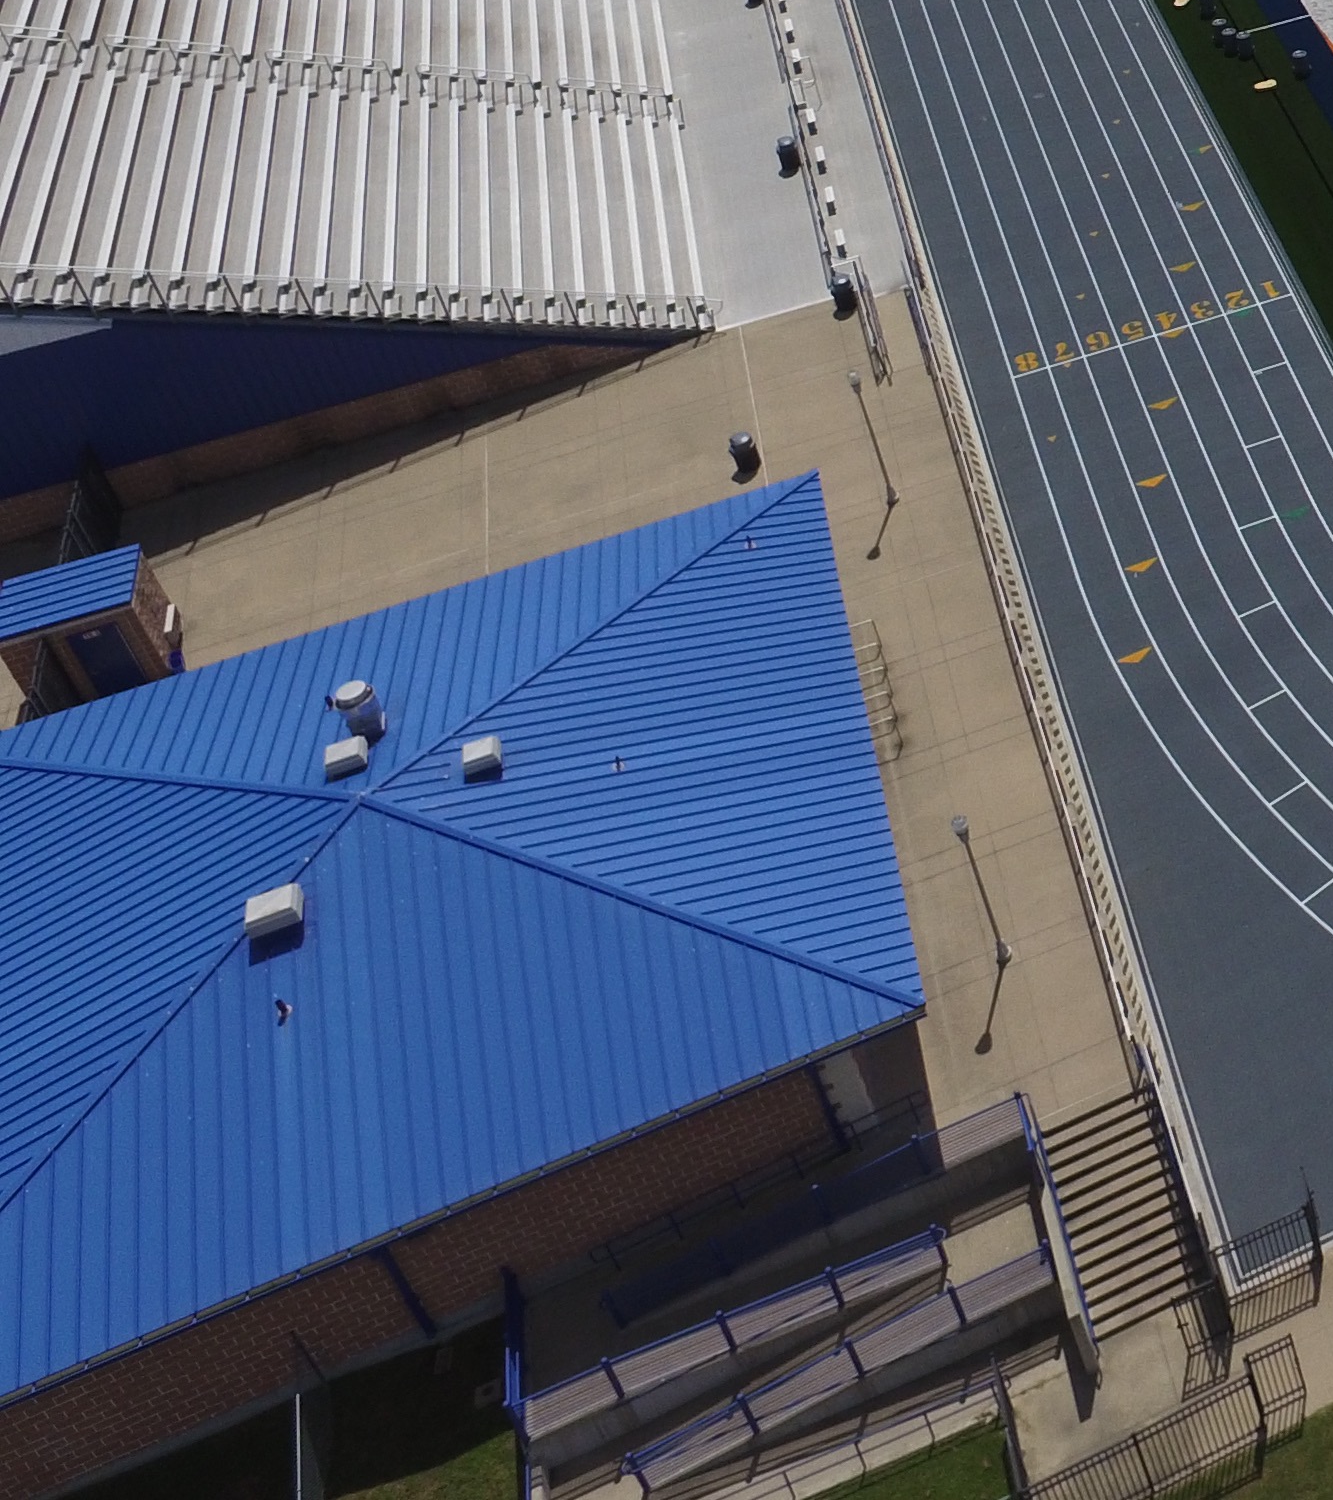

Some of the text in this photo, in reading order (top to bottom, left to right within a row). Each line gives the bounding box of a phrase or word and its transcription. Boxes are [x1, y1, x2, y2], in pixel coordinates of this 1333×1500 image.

[1014, 280, 1280, 372] 1 2 3 4 5 6 7 8
